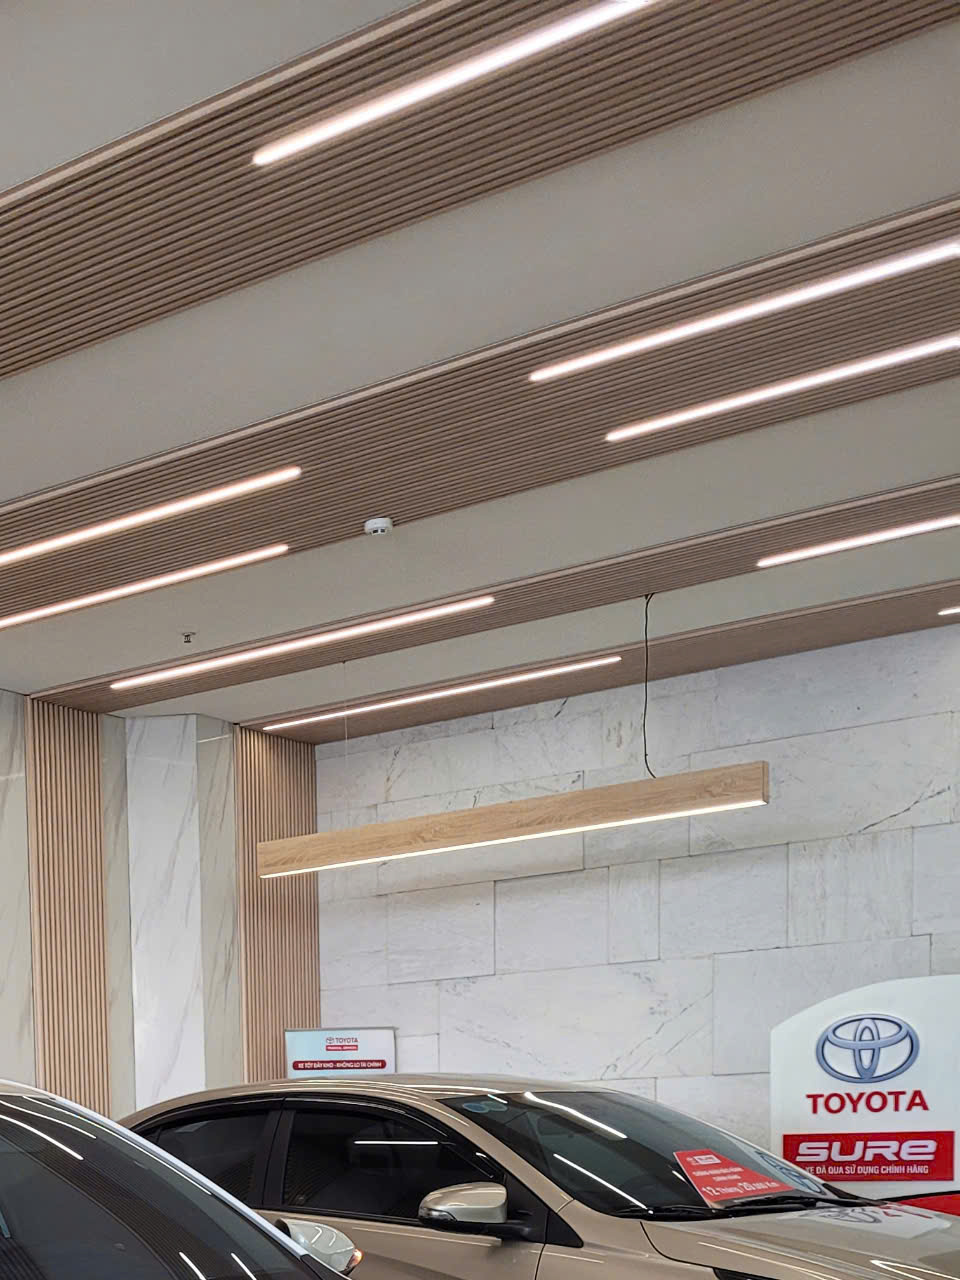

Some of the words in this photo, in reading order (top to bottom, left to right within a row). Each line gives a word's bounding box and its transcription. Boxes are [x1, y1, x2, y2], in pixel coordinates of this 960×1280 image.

[806, 1089, 929, 1114] TOYOTA
[816, 1164, 826, 1174] ĐÃ
[828, 1166, 844, 1174] QUA
[845, 1164, 856, 1174] SỬ
[857, 1165, 879, 1176] DỤNG
[881, 1164, 905, 1174] CHÍNH
